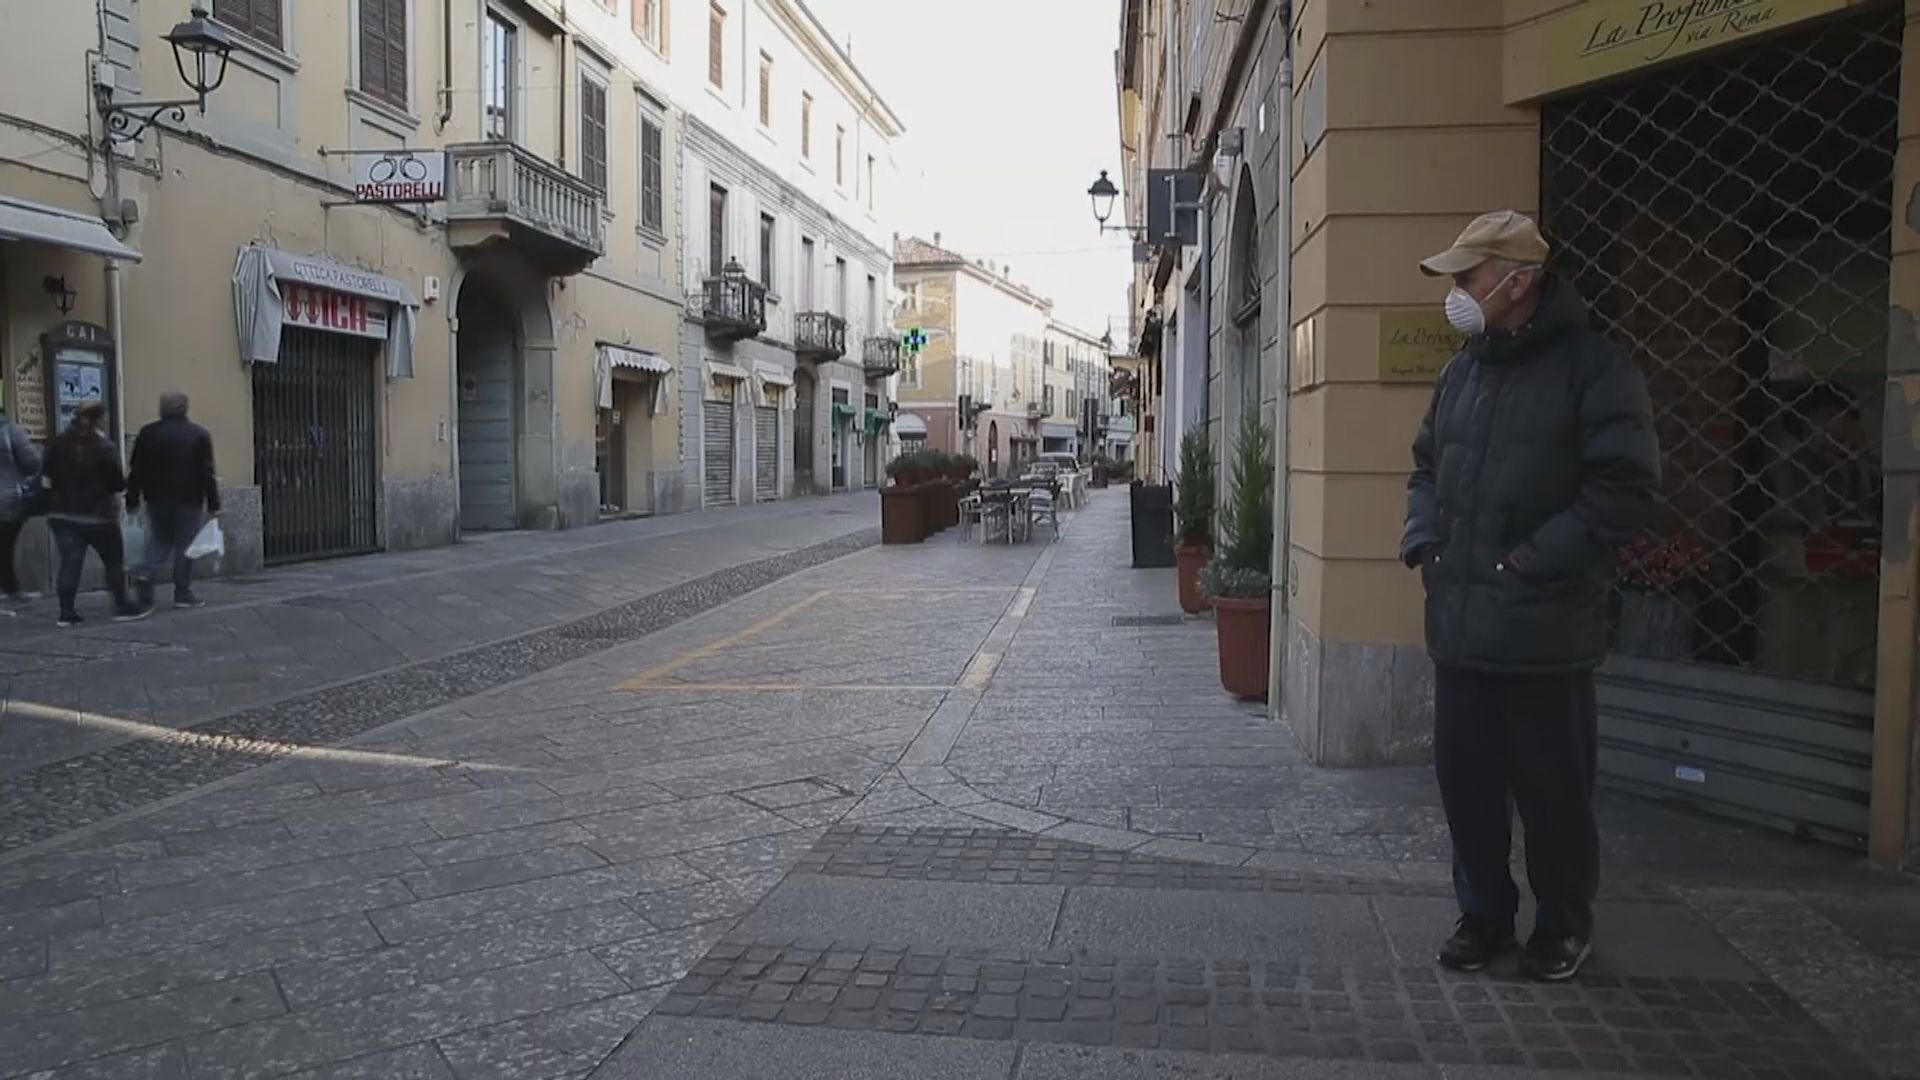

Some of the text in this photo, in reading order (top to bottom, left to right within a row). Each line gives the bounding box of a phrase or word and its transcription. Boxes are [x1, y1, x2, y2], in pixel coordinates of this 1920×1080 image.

[1585, 0, 1745, 60] La Profum
[1686, 8, 1776, 44] via Roma
[356, 182, 441, 199] PASTORELLI
